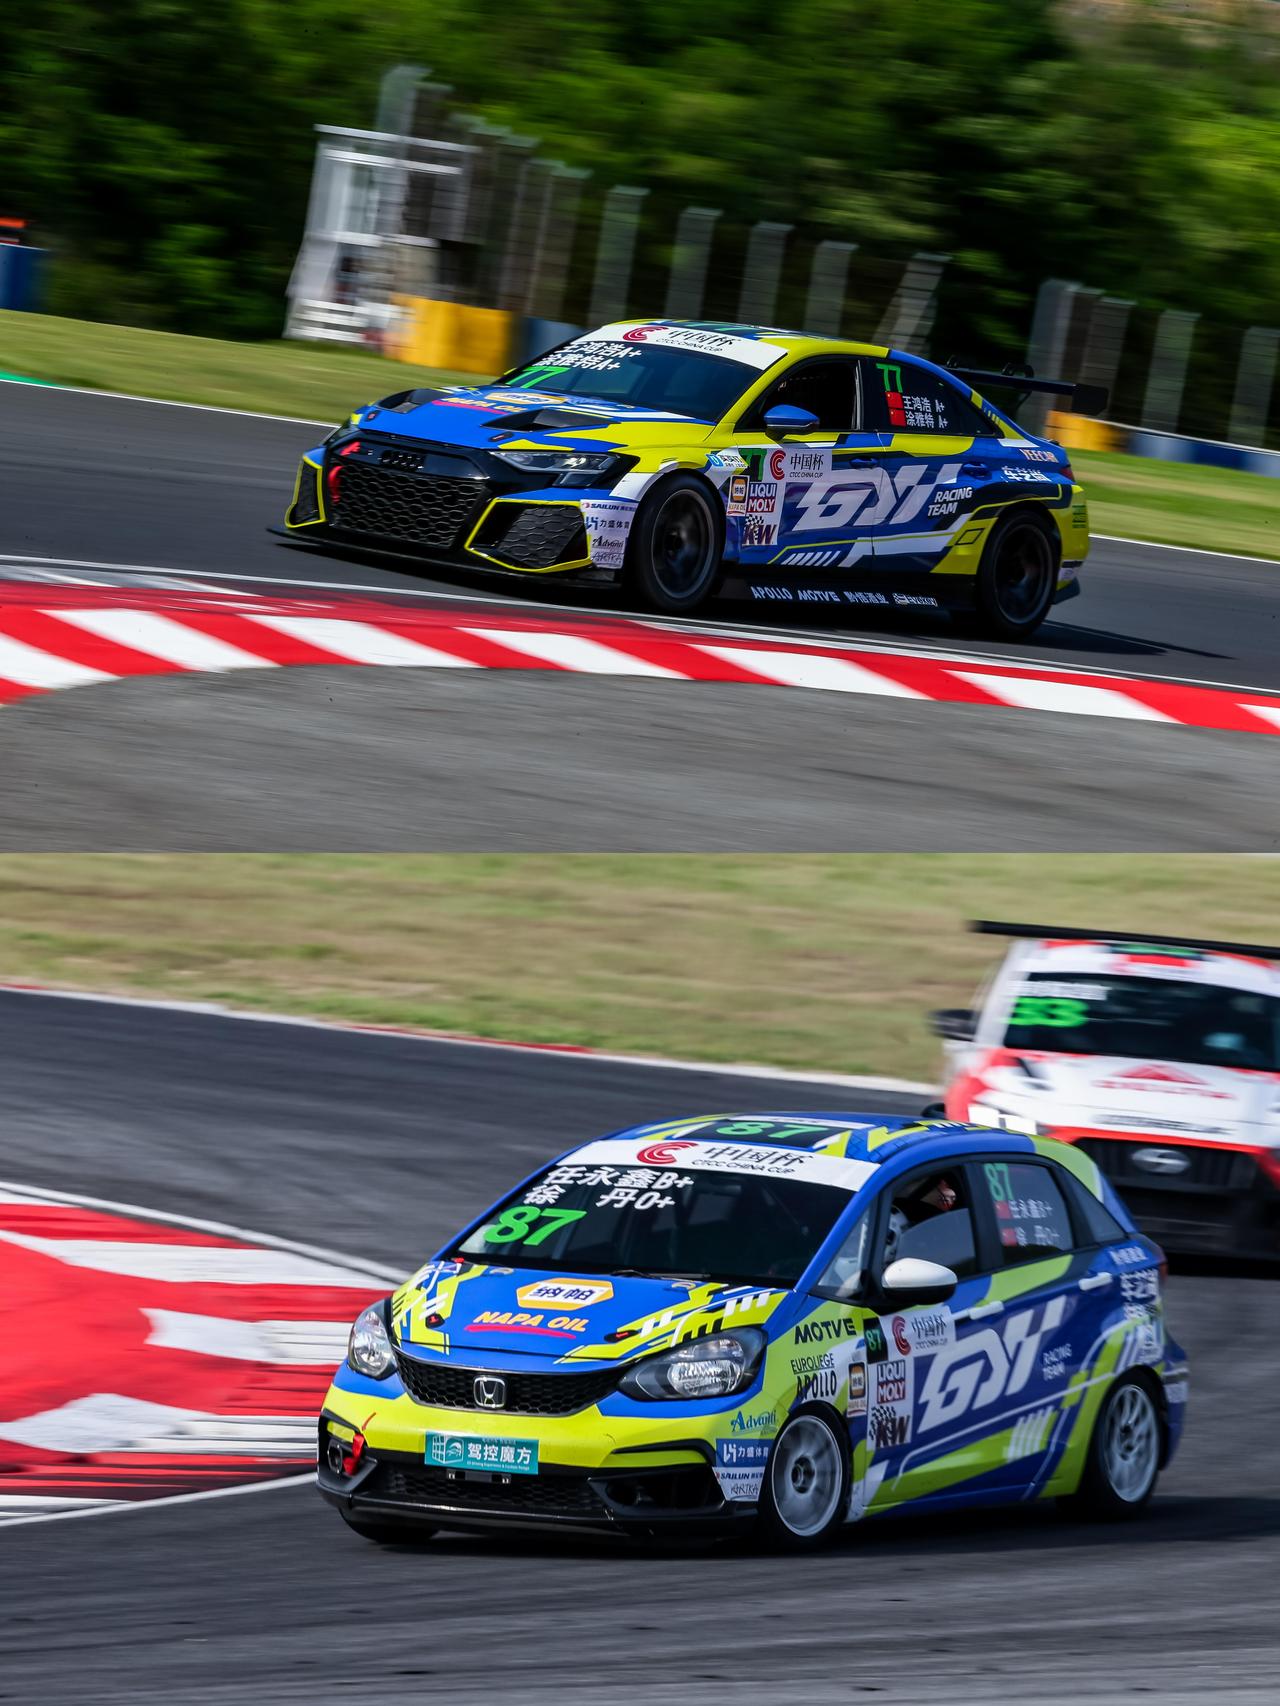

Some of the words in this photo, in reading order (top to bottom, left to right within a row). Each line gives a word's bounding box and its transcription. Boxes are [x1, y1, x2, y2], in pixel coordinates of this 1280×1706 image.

[678, 340, 703, 350] CHINA
[505, 365, 569, 388] 77
[876, 363, 903, 392] 77
[790, 453, 825, 470] 中国杯
[750, 484, 776, 497] LIQUI
[934, 487, 973, 503] RACING
[591, 503, 619, 511] SAILUN
[747, 498, 775, 512] MOLY
[927, 502, 958, 517] TEAM
[743, 524, 777, 545] KW
[750, 586, 793, 601] APOLLO
[797, 589, 841, 602] MOTVE
[715, 1121, 829, 1138] 87
[692, 1158, 724, 1169] CTCC
[725, 1161, 765, 1172] CHINA
[767, 1166, 796, 1174] CUP
[703, 1146, 813, 1166] 中国杯
[984, 1163, 1014, 1201] 87
[523, 1184, 566, 1205] 徐
[483, 1205, 588, 1246] 87
[533, 1286, 595, 1301] 纳帕
[473, 1311, 545, 1327] NAPA
[547, 1317, 589, 1332] OIL
[795, 1318, 856, 1345] MOTVE
[865, 1329, 882, 1351] 87
[879, 1361, 905, 1381] LIQUI
[796, 1370, 837, 1400] APOLLO
[878, 1381, 905, 1402] MOLY
[467, 1441, 532, 1465] 驾控魔方
[721, 1472, 750, 1480] SAILUN
